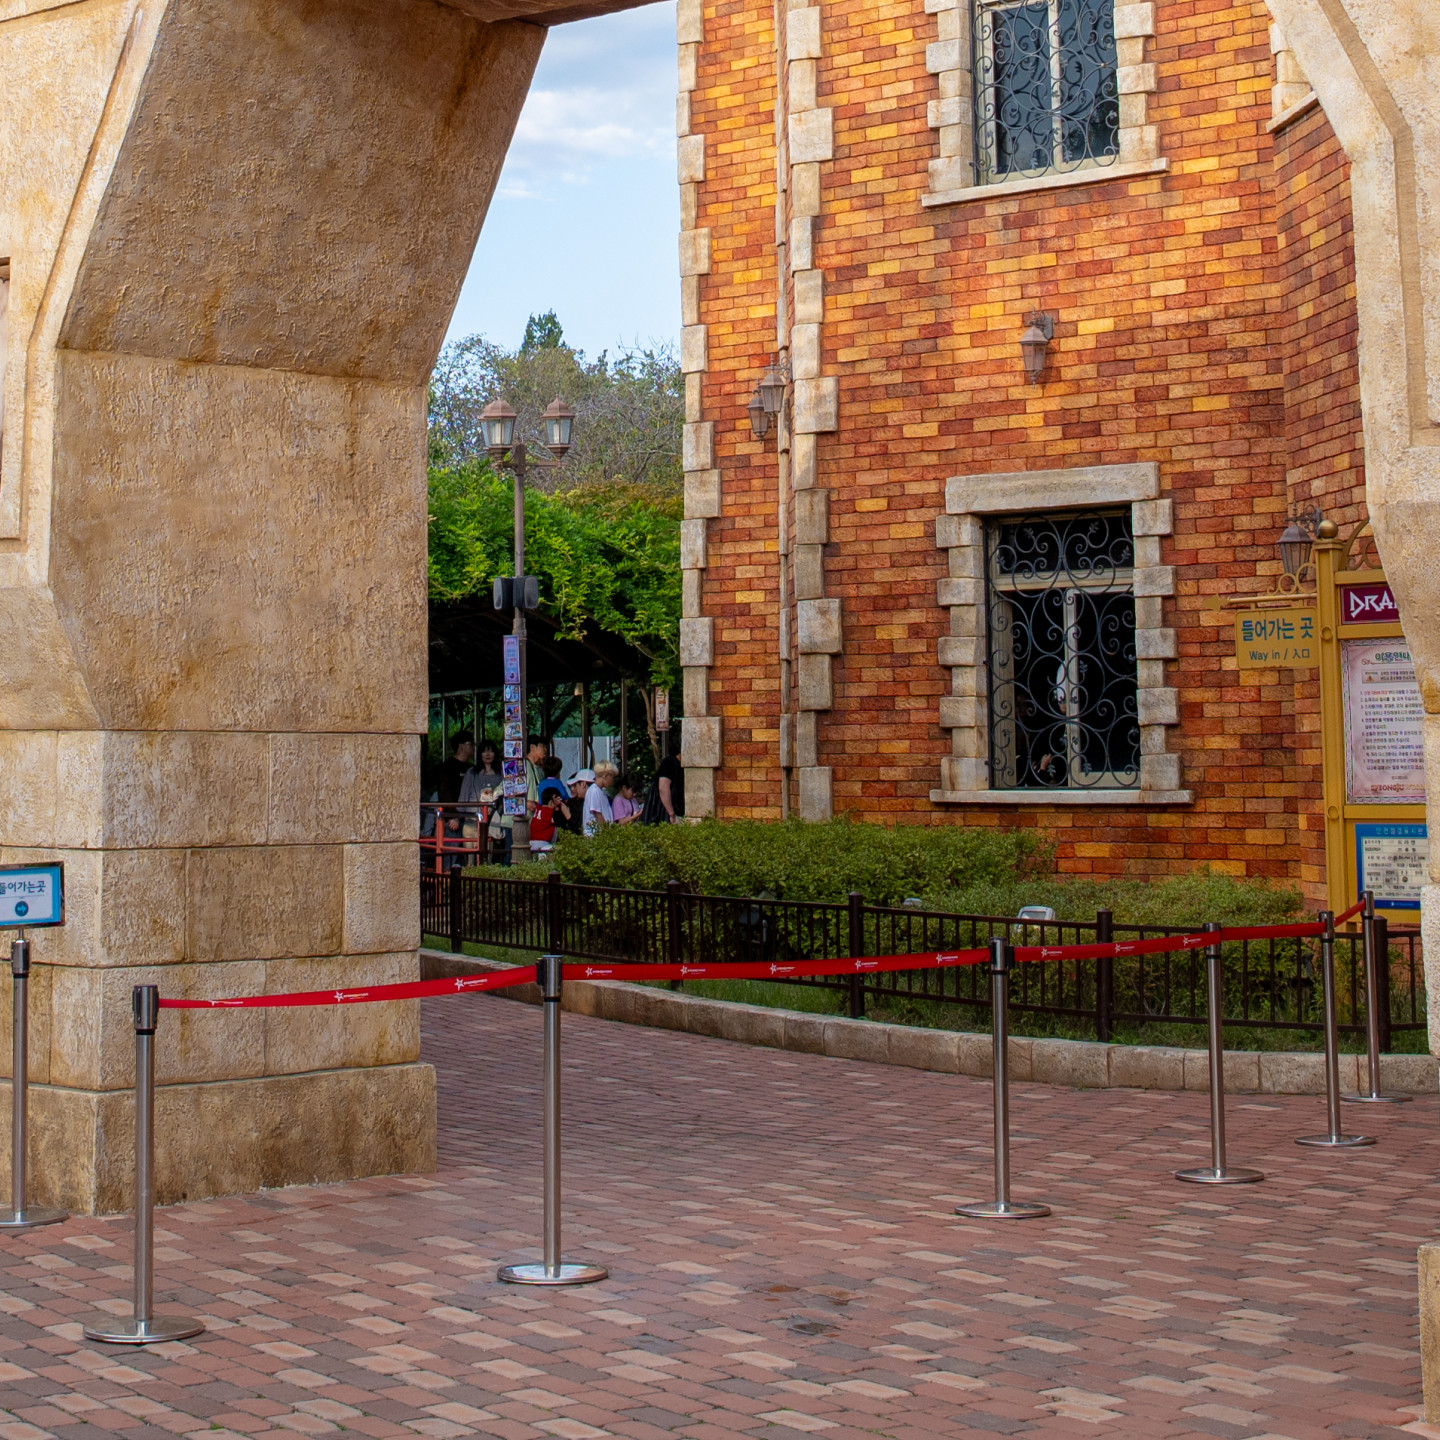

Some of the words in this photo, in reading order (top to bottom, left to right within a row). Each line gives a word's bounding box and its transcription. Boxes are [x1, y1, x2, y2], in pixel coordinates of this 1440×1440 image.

[1350, 590, 1398, 618] DRA
[1241, 618, 1295, 641] 들어가는
[1300, 617, 1314, 639] 곳
[1249, 650, 1268, 661] Way
[1272, 649, 1280, 659] in
[1292, 648, 1310, 659] 入口
